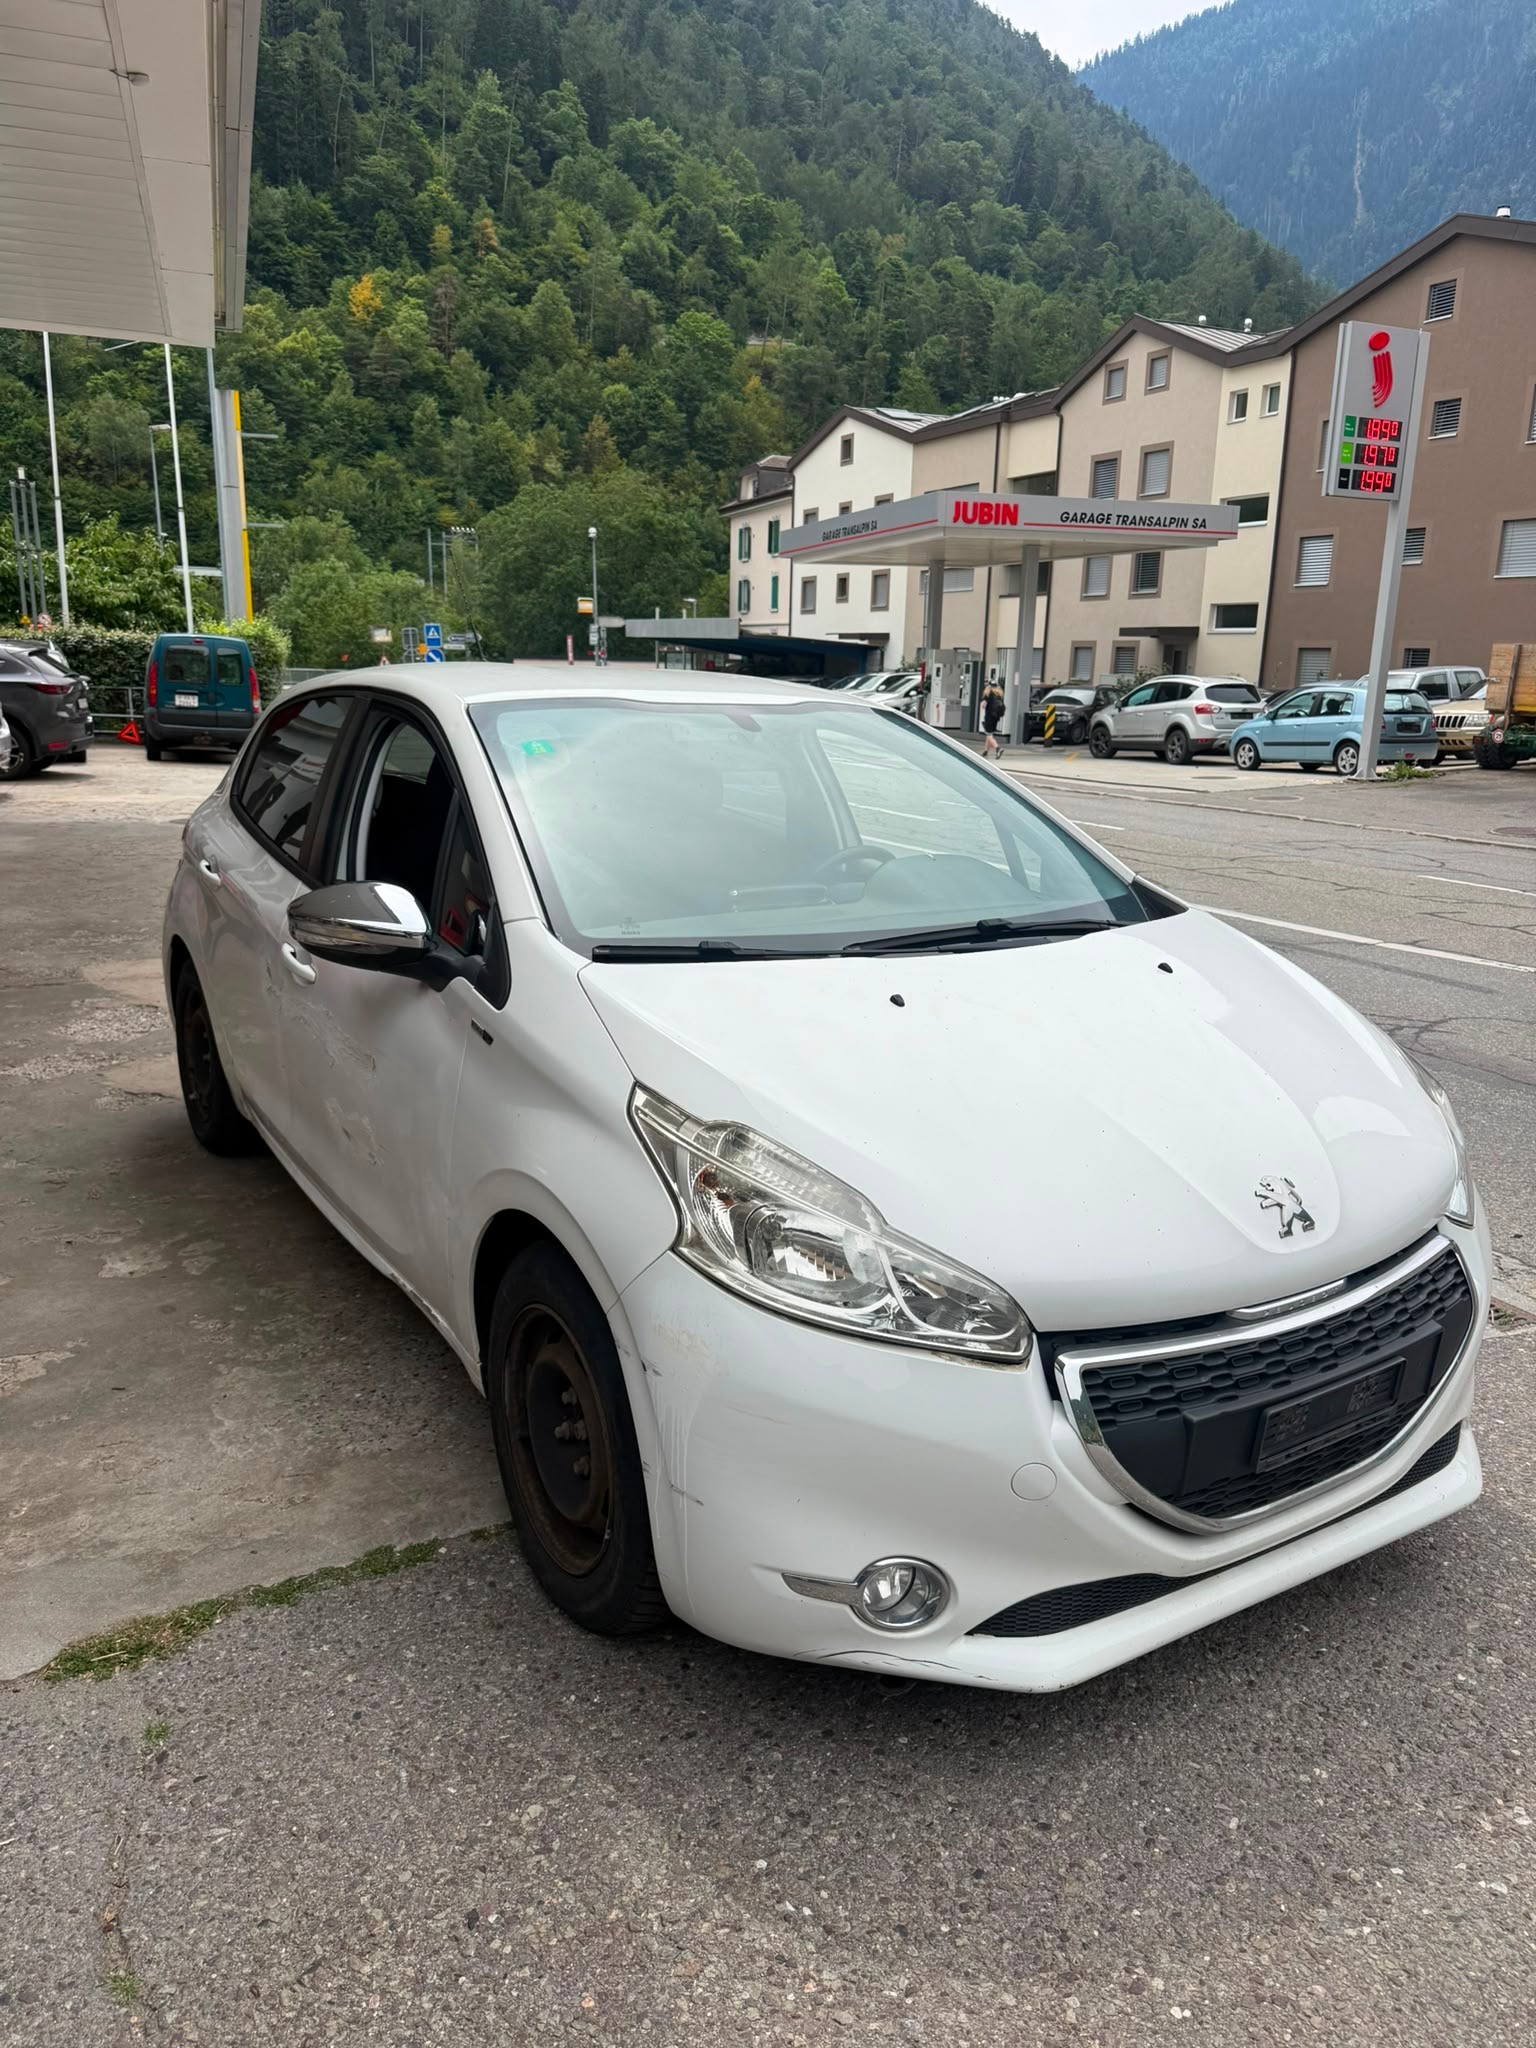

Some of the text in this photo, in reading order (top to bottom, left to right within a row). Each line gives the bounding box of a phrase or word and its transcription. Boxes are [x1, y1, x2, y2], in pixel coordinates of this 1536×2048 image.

[953, 501, 1019, 526] JUBIN
[1060, 511, 1207, 529] GARAGE TRANSALPIN SA
